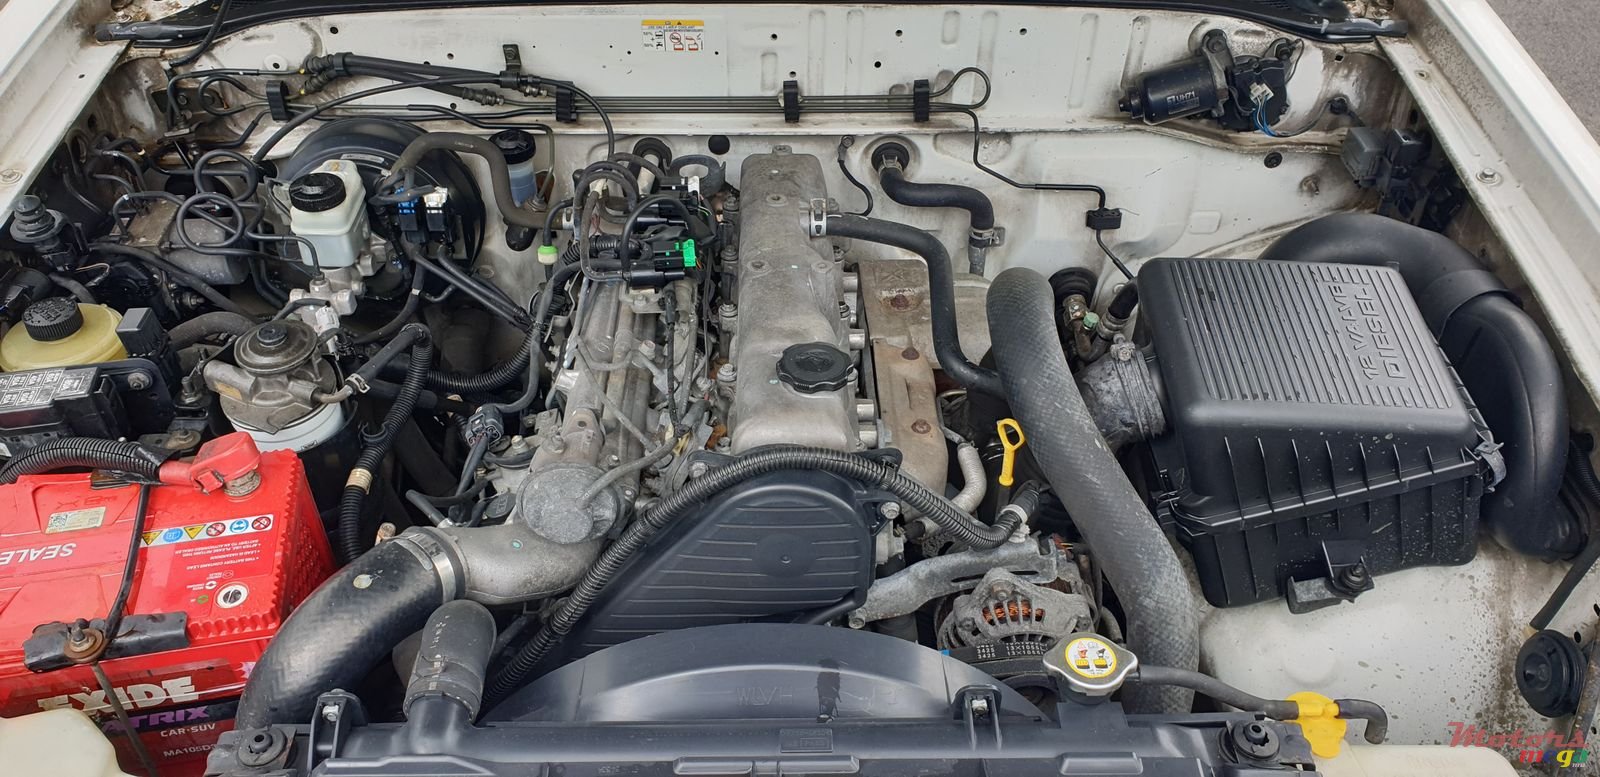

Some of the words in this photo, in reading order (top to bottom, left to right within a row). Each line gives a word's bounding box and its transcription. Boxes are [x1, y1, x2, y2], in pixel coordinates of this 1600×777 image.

[1327, 285, 1370, 351] VALVE
[1354, 286, 1406, 379] DIESEL
[37, 676, 199, 714] EXIDE
